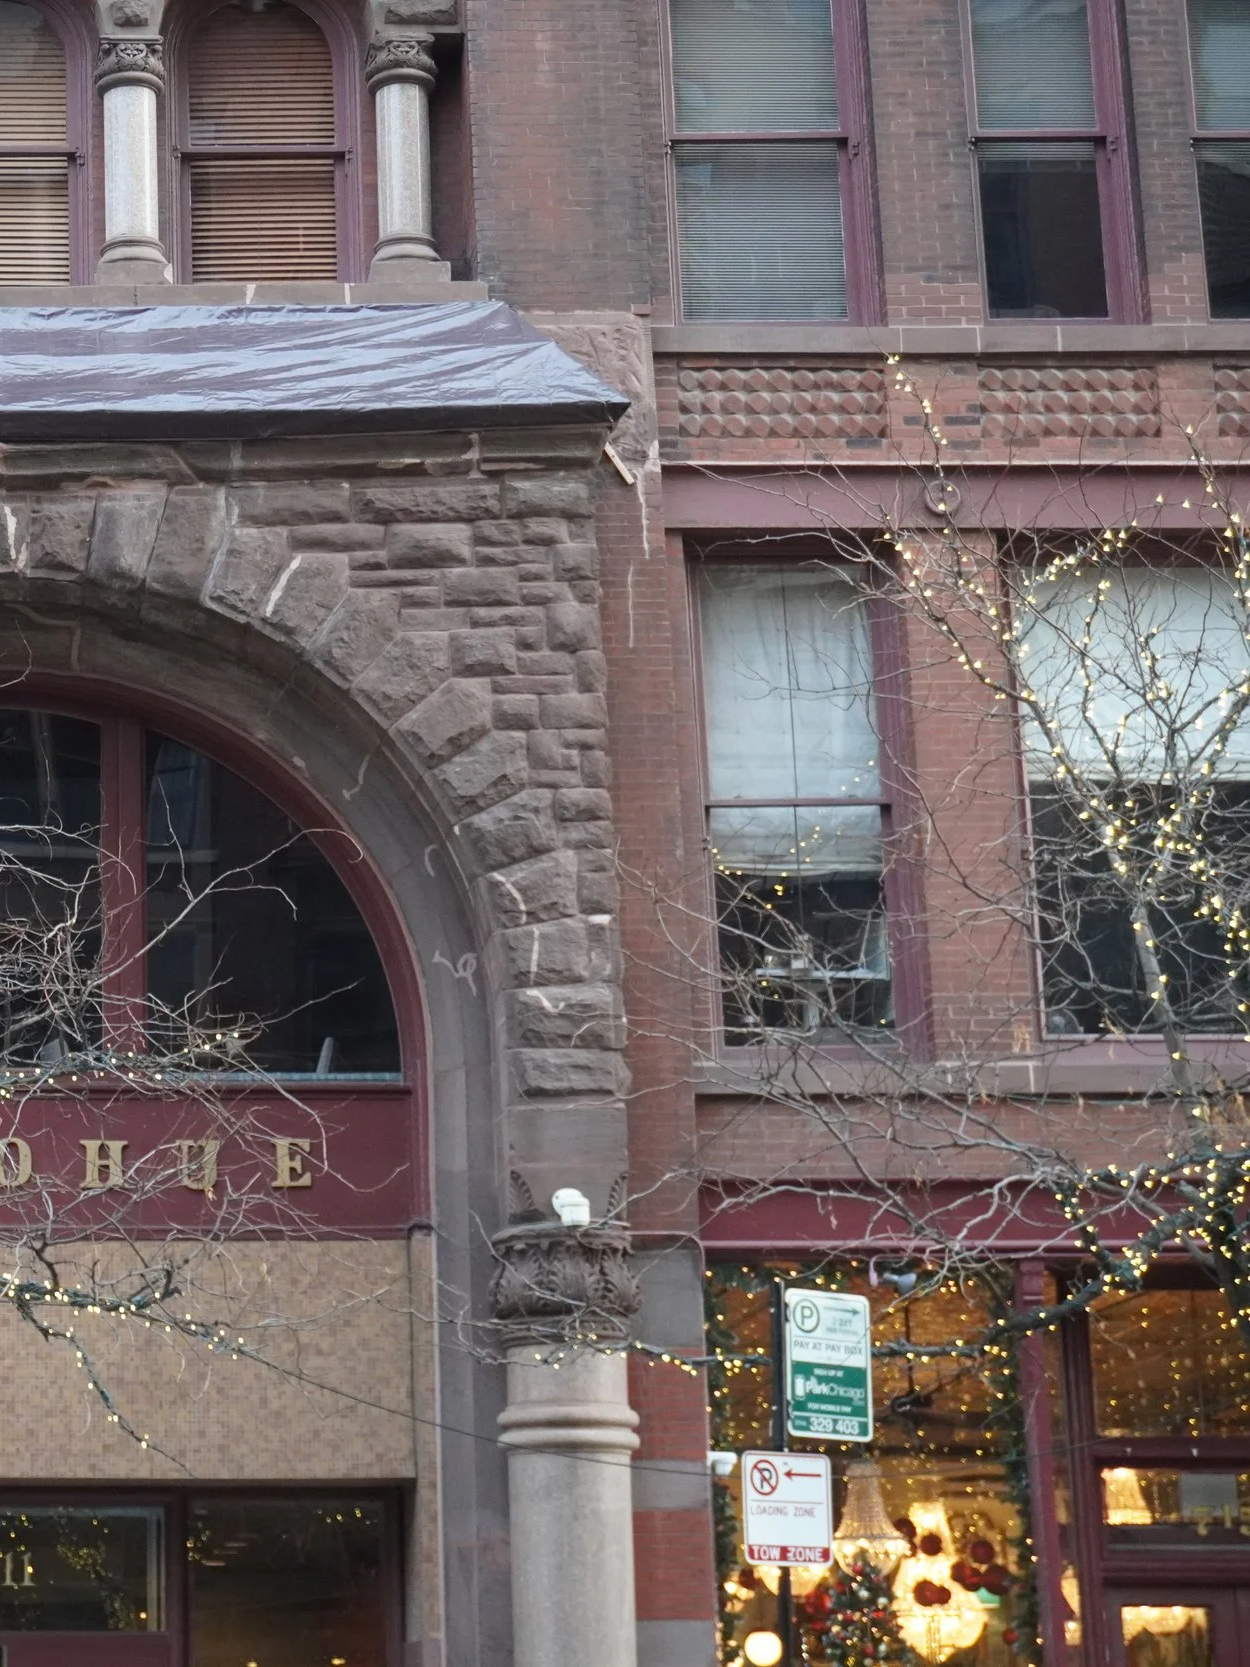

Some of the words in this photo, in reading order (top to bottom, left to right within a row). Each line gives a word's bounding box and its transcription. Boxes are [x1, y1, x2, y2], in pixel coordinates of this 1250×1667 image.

[794, 1340, 810, 1348] PAY
[812, 1342, 822, 1350] AT
[826, 1344, 841, 1352] PAY
[844, 1346, 862, 1355] BOX
[806, 1380, 865, 1400] ParkChicago
[810, 1417, 833, 1432] 329
[836, 1420, 859, 1434] 403
[750, 1505, 788, 1516] LOADING
[793, 1506, 816, 1518] ZONE
[752, 1546, 781, 1560] TOW
[786, 1547, 824, 1562] ZONE
